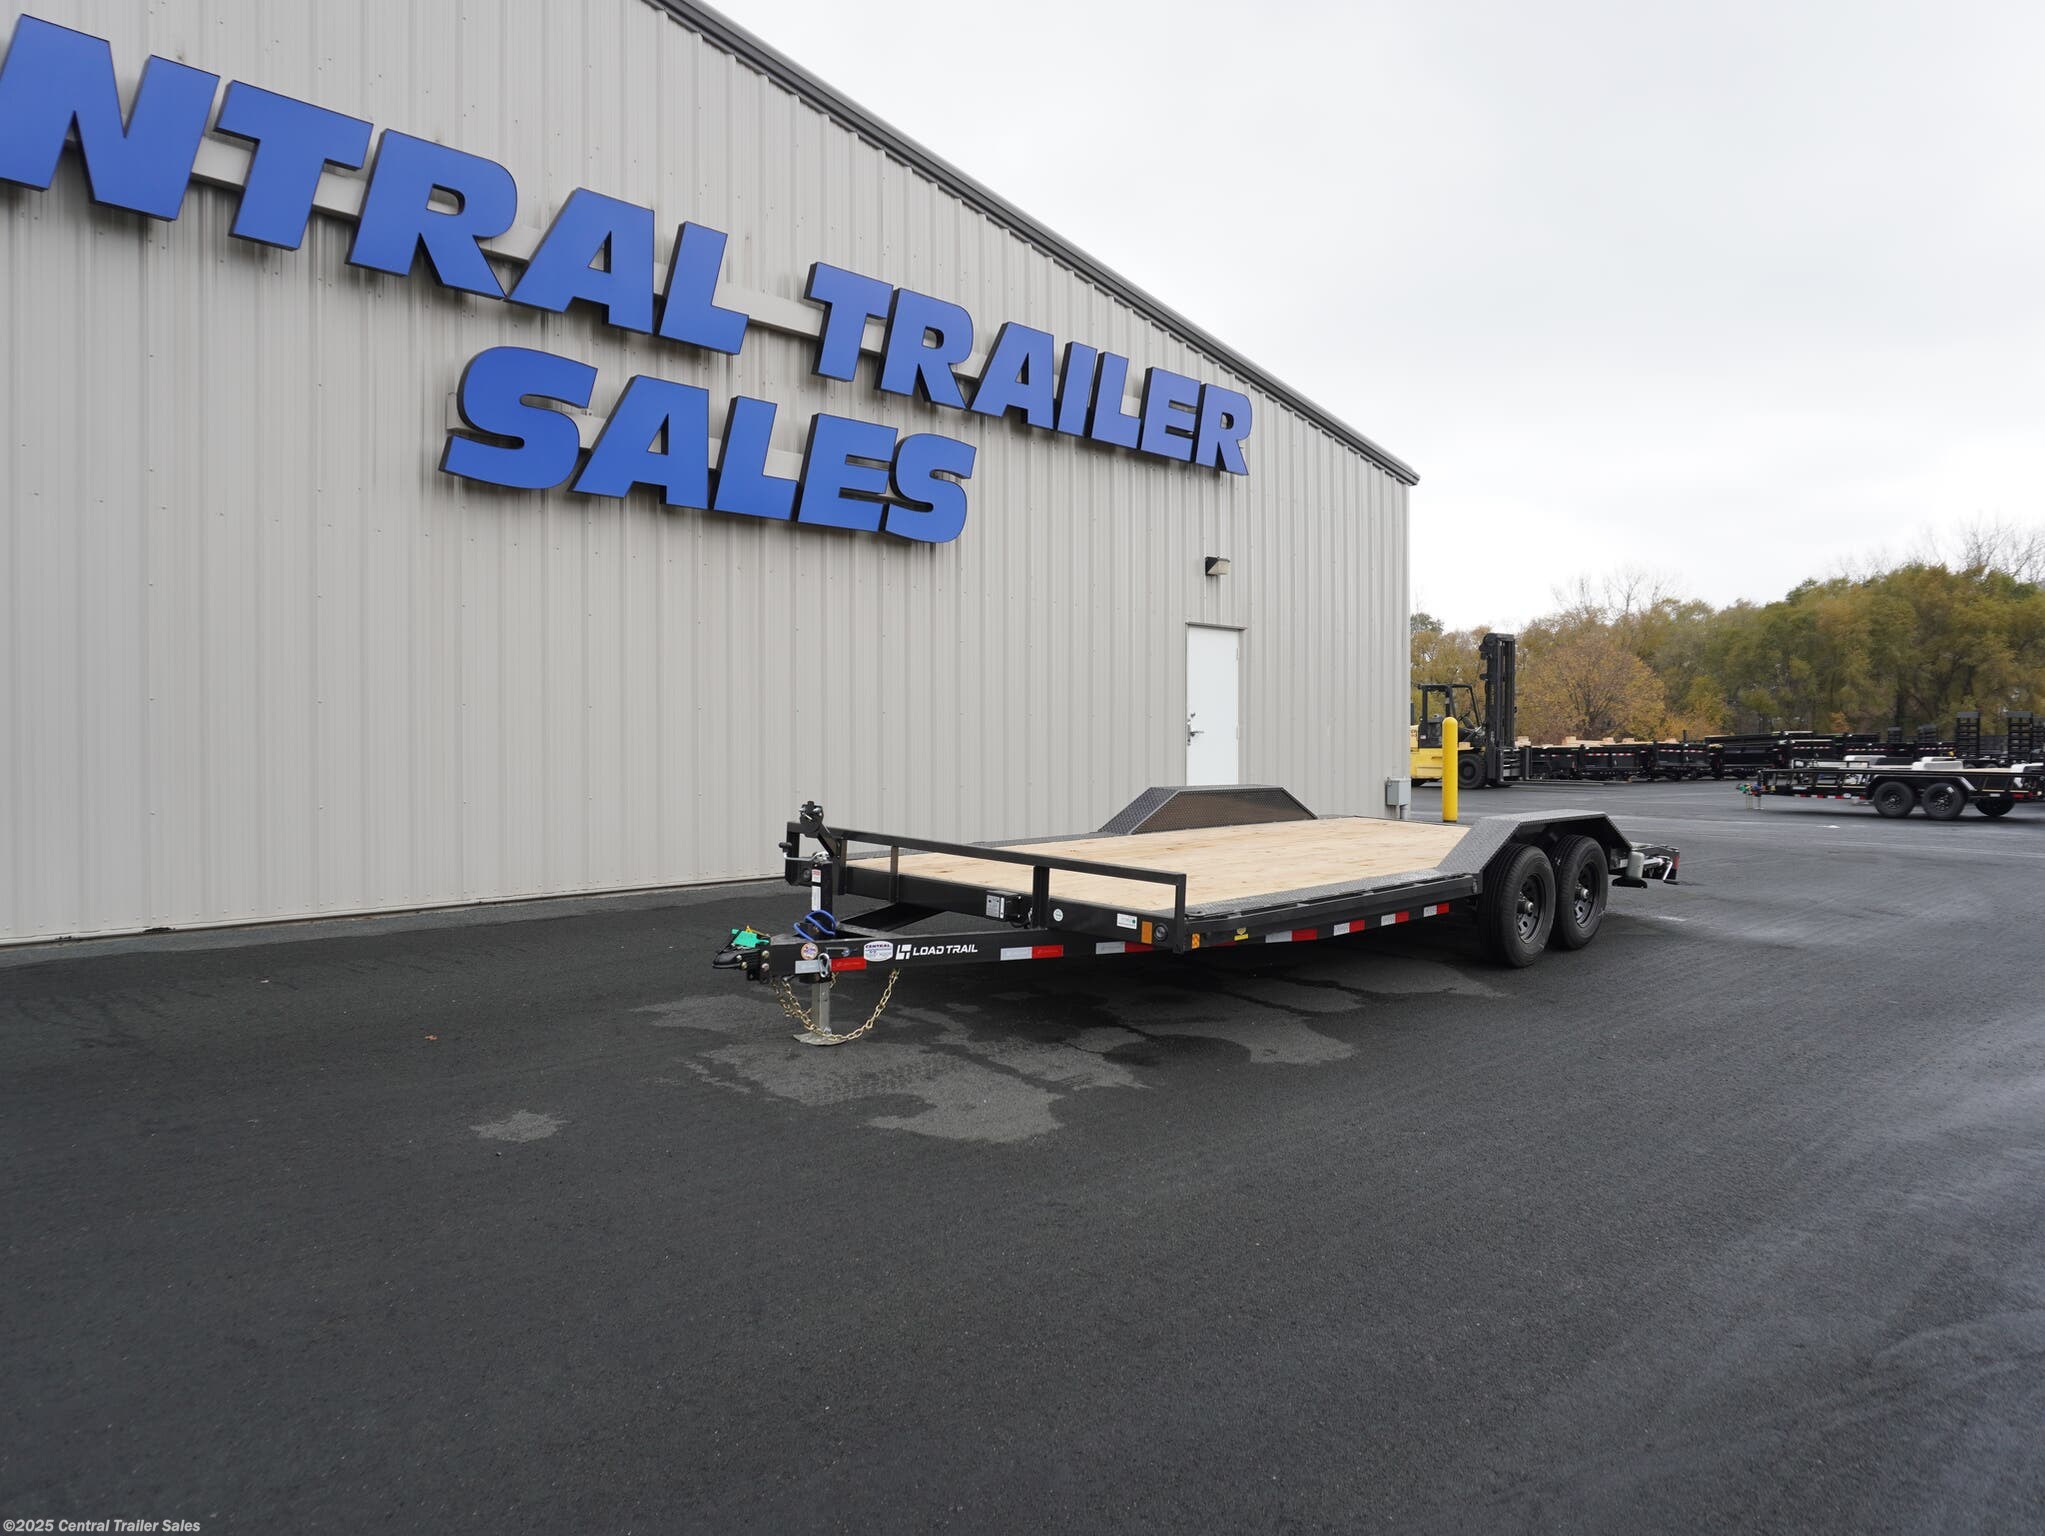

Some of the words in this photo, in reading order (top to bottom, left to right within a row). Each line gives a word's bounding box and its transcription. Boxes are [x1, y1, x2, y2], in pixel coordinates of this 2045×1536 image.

[438, 346, 977, 543] SALES
[804, 262, 1252, 476] TRAILER
[912, 945, 945, 956] LOAD
[945, 944, 978, 954] TRAIL
